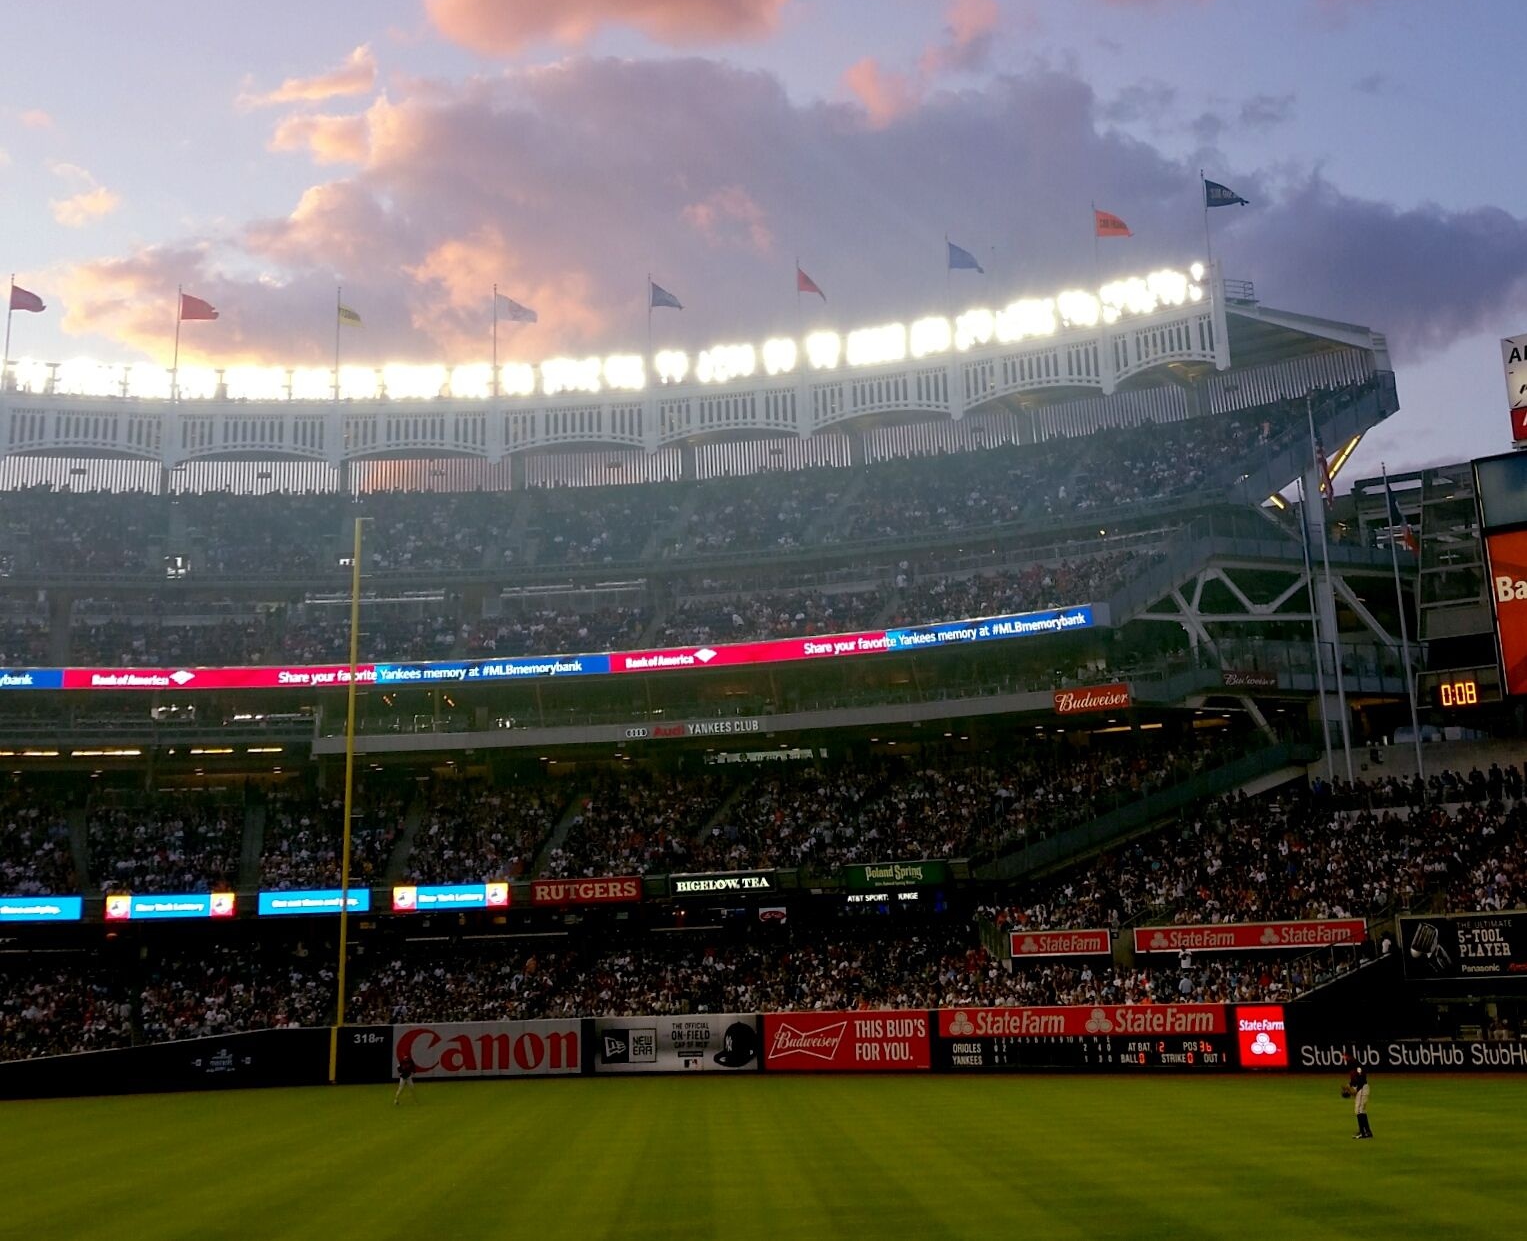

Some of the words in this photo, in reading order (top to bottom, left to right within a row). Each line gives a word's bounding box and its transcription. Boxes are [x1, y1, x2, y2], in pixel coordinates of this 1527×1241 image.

[804, 642, 833, 654] Share
[833, 641, 857, 655] your
[858, 637, 897, 650] favorite
[898, 632, 936, 646] Yankees
[938, 626, 977, 641] memory
[979, 625, 990, 637] at
[992, 613, 1087, 636] #MLBmemorybank
[278, 671, 308, 683] Share
[310, 671, 336, 685] your
[380, 667, 421, 680] Yankees
[423, 664, 466, 680] memory
[468, 666, 479, 677] at
[482, 660, 582, 676] #MLBmemorybank
[1055, 691, 1129, 712] Budweiser
[1441, 681, 1477, 706] 0:08
[653, 724, 685, 738] Audi
[687, 722, 732, 735] YANKEES
[734, 720, 759, 731] CLUB
[865, 865, 893, 881] Poland
[894, 864, 923, 880] Spring
[534, 881, 637, 901] RUTGERS
[676, 880, 739, 893] BIGELOW
[742, 877, 770, 888] TEA
[1456, 921, 1471, 929] THE
[1474, 919, 1512, 929] ULTIMATE
[1457, 928, 1504, 943] 5-TOOL
[1459, 942, 1511, 958] PLAYER
[1461, 963, 1500, 973] Panasonic
[672, 1022, 683, 1030] THE
[684, 1022, 709, 1030] OFFICIAL
[854, 1020, 884, 1039] THIS
[886, 1019, 926, 1038] BUD'S
[632, 1036, 653, 1046] NEW
[671, 1030, 710, 1041] ON-FIELD
[774, 1031, 839, 1049] Budweiser
[396, 1028, 578, 1073] Canon
[632, 1045, 653, 1056] ERA
[855, 1043, 880, 1061] FOR
[883, 1042, 914, 1060] YOU.
[952, 1043, 982, 1054] ORIOLES
[1128, 1042, 1137, 1052] AT
[1183, 1041, 1198, 1052] POS
[1388, 1043, 1464, 1066] StubHub
[952, 1055, 983, 1066] YANKEES
[1121, 1054, 1138, 1063] BALL
[1161, 1053, 1186, 1063] STRIKE
[1204, 1053, 1218, 1063] OUT
